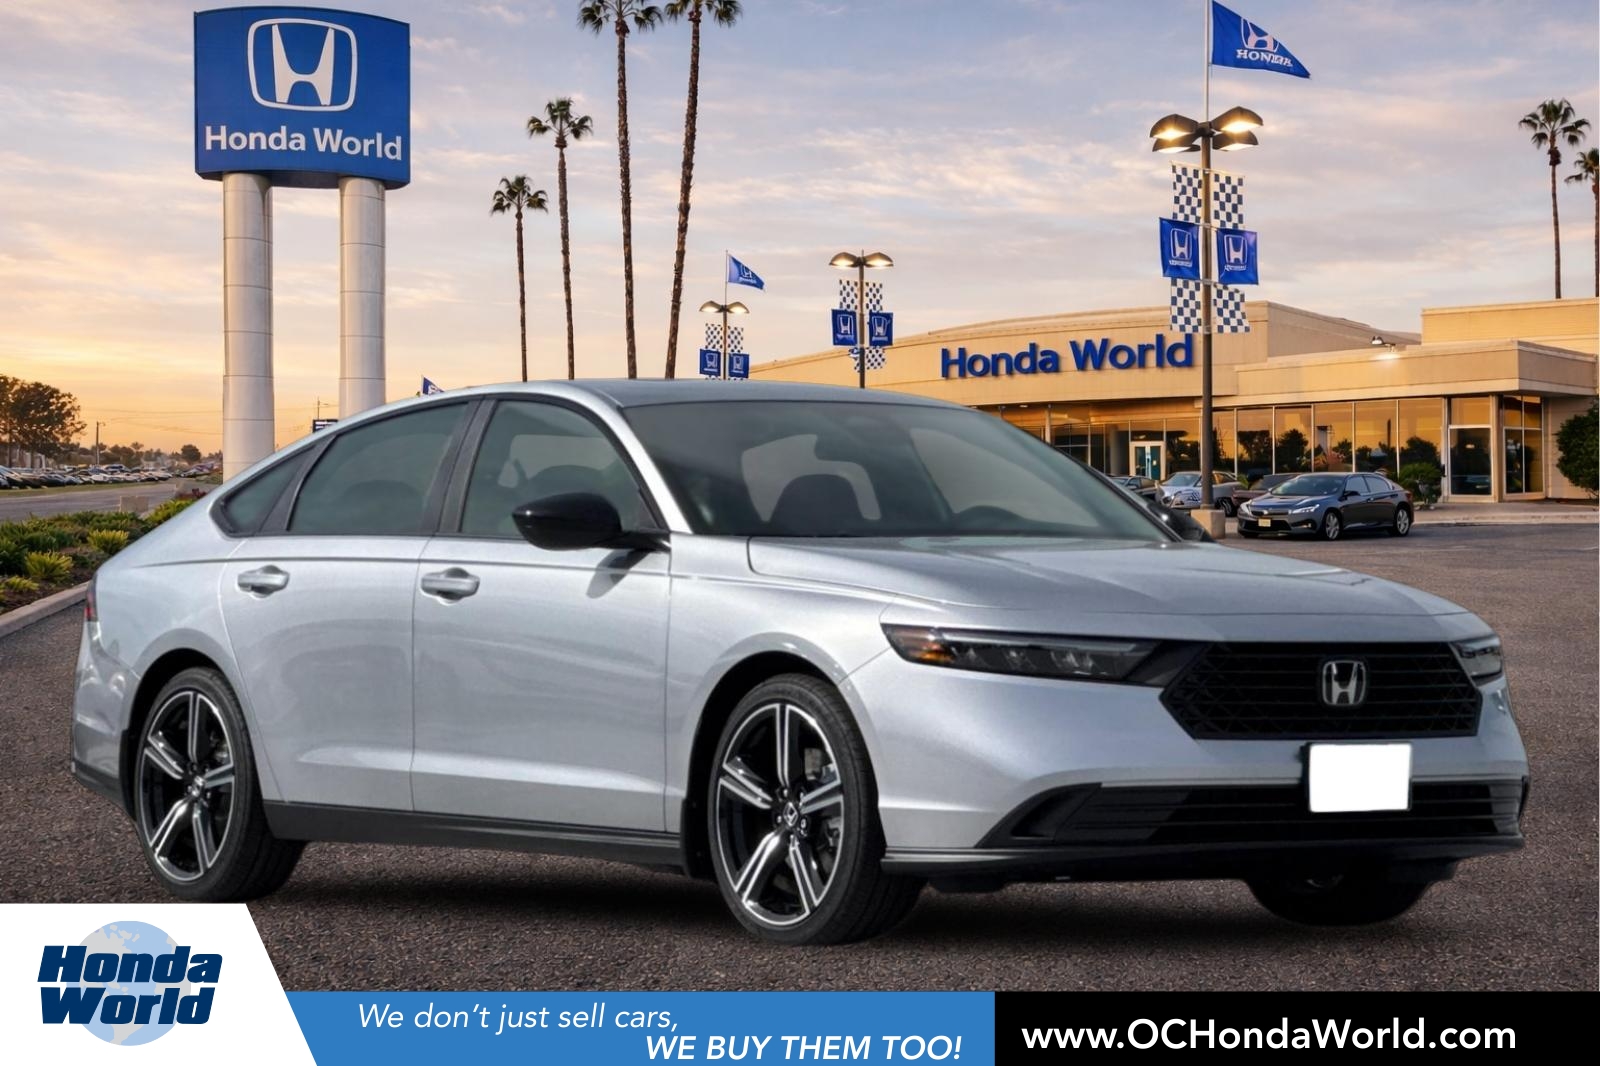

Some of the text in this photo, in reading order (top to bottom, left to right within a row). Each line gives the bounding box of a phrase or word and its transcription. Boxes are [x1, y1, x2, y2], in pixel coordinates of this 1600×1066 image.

[206, 125, 402, 161] Honda World
[941, 333, 1194, 379] Honda World
